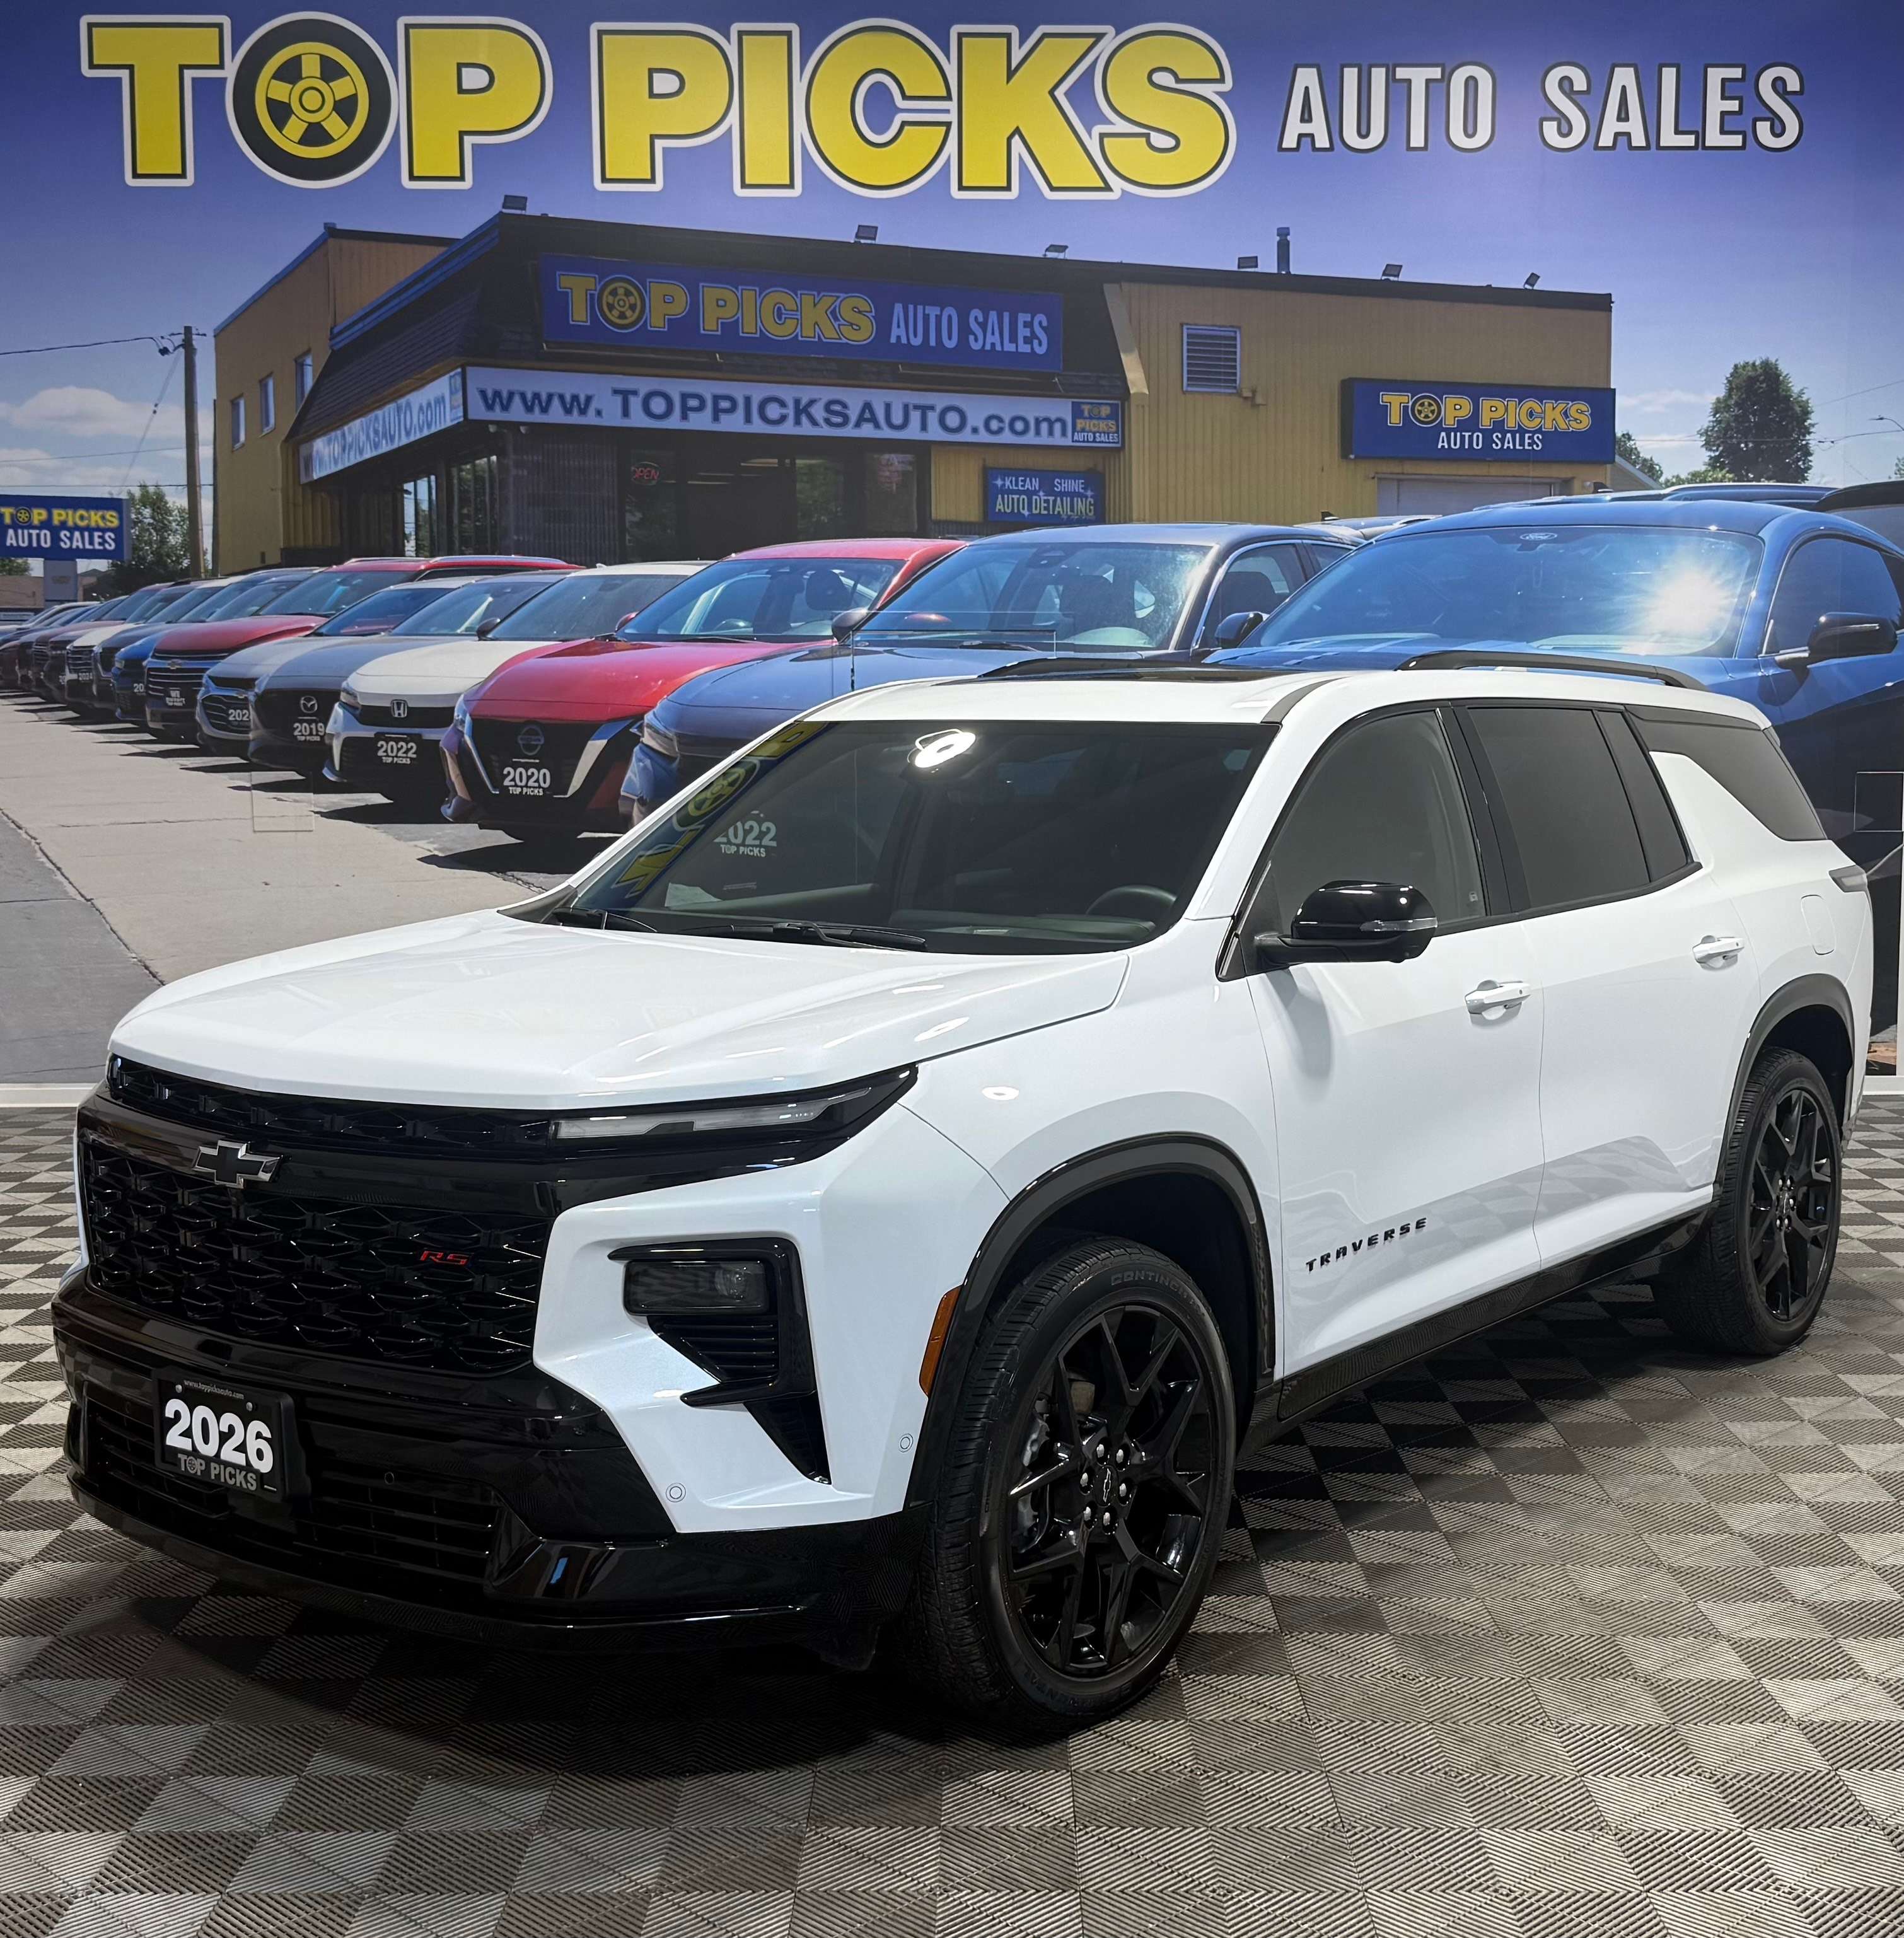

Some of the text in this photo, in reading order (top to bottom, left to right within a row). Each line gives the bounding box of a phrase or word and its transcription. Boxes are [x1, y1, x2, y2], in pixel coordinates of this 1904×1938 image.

[81, 11, 1236, 199] TOP PICKS
[1277, 61, 1805, 153] AUTO SALES
[556, 271, 876, 345] TOP PICKS
[890, 303, 1048, 354] AUTO SALES
[1081, 404, 1111, 418] TOP
[1379, 392, 1591, 431] TOP PICKS
[1076, 419, 1117, 433] PICKS
[1074, 432, 1119, 442] AUTO SALES
[1437, 432, 1543, 450] AUTO SALES
[1005, 477, 1085, 492] KLEAN SHINE
[996, 494, 1094, 516] AUTO DETAILING
[0, 507, 120, 528] TOP PICKS
[6, 528, 115, 550] AUTO SALES
[228, 709, 251, 721] 202
[293, 722, 325, 736] 2019
[377, 741, 417, 758] 2022
[503, 767, 550, 788] 2020
[523, 787, 543, 796] PICKS
[720, 844, 765, 857] TOP PICKS
[1306, 1217, 1427, 1272] TRAVERSE
[420, 1250, 470, 1265] RS
[165, 1398, 274, 1473] 2026
[178, 1453, 257, 1491] TOP PICKS
